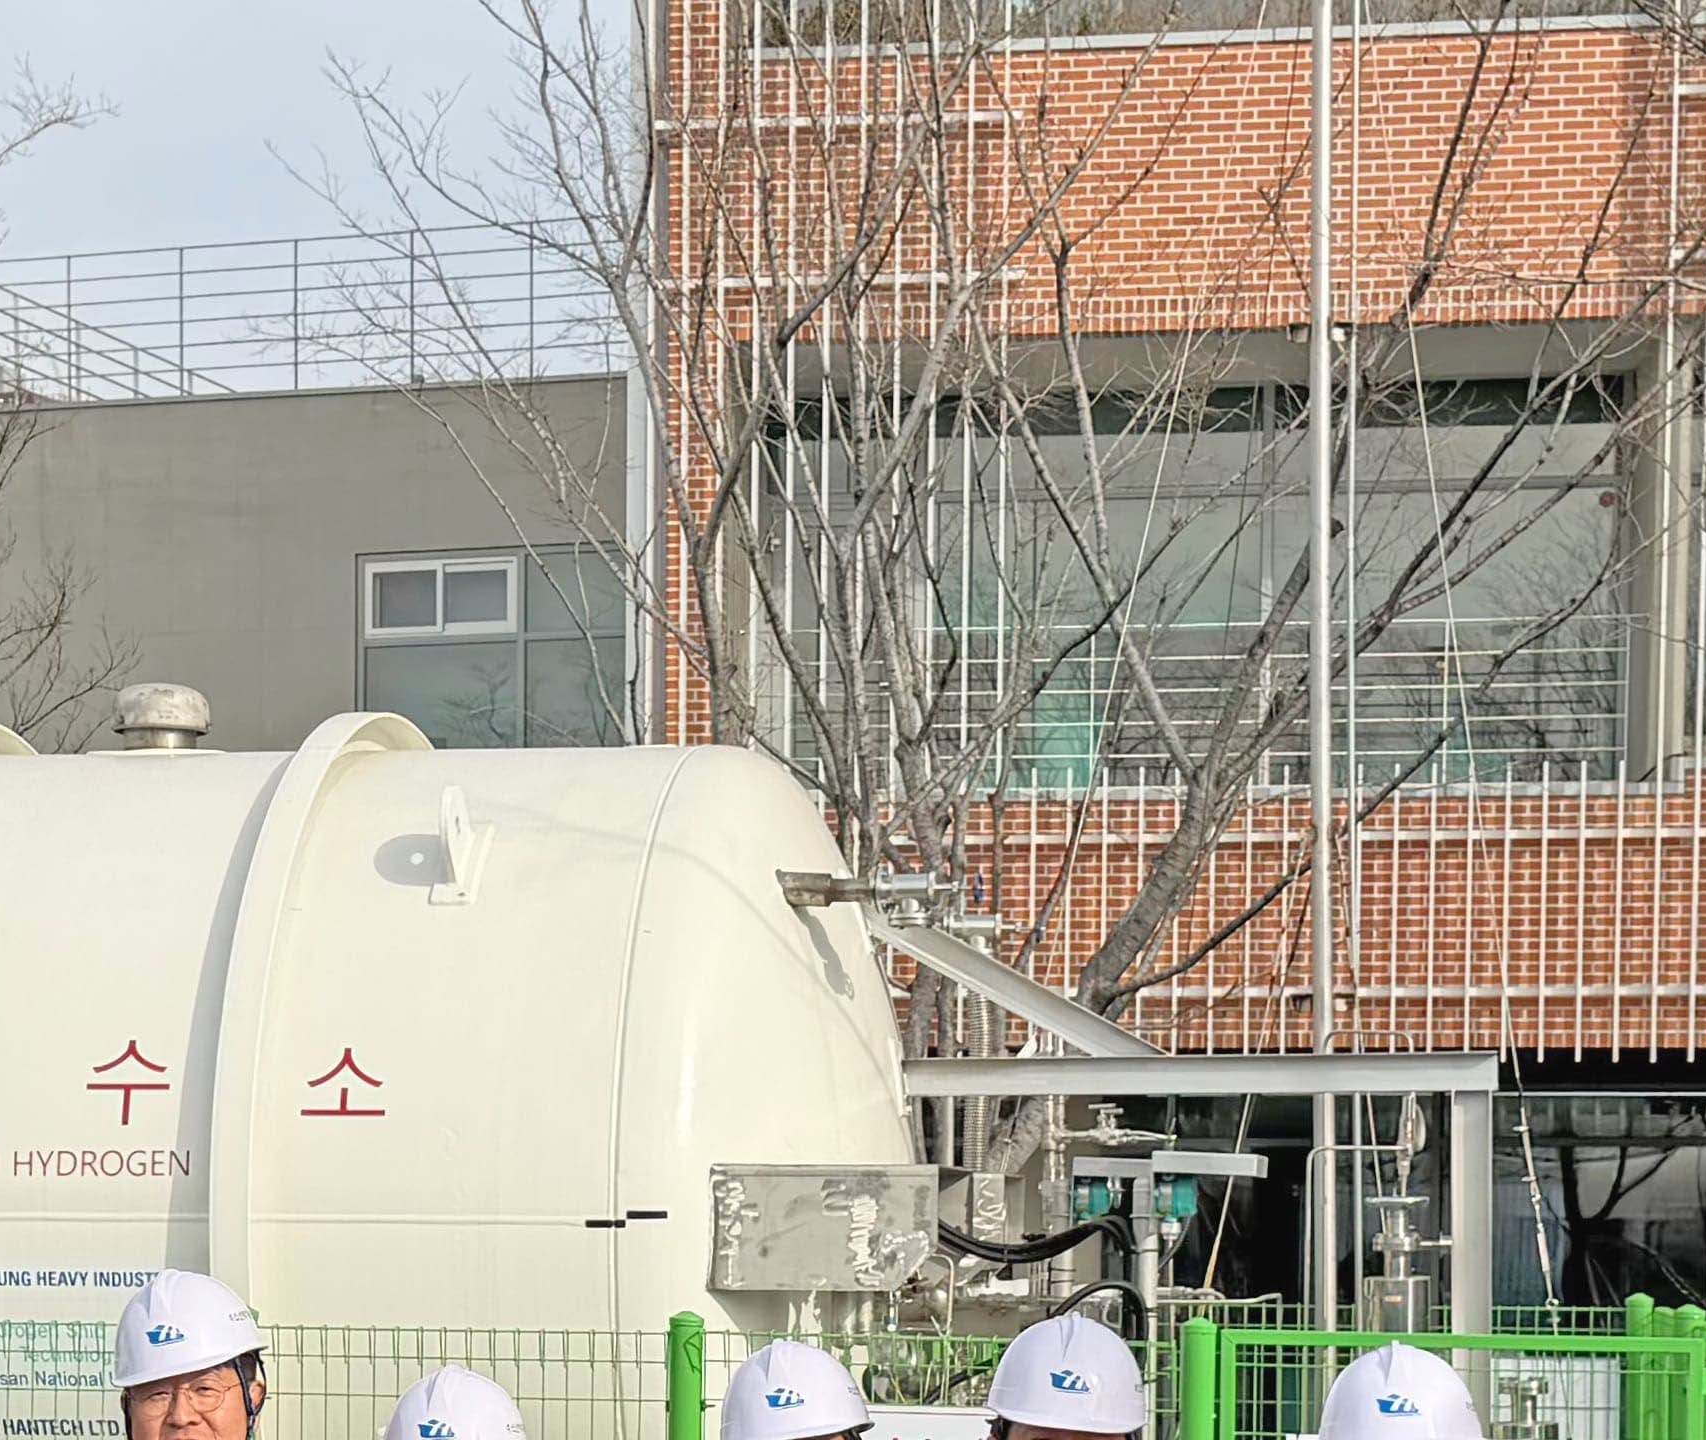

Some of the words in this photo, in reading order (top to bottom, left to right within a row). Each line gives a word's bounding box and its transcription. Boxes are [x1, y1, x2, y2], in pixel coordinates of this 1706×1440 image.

[14, 1150, 190, 1177] HYDROGEN
[36, 1270, 88, 1287] HEAVY
[93, 1271, 159, 1288] INDUST
[35, 1370, 104, 1387] National
[3, 1419, 84, 1436] HANTECH
[89, 1420, 126, 1437] LTD.
